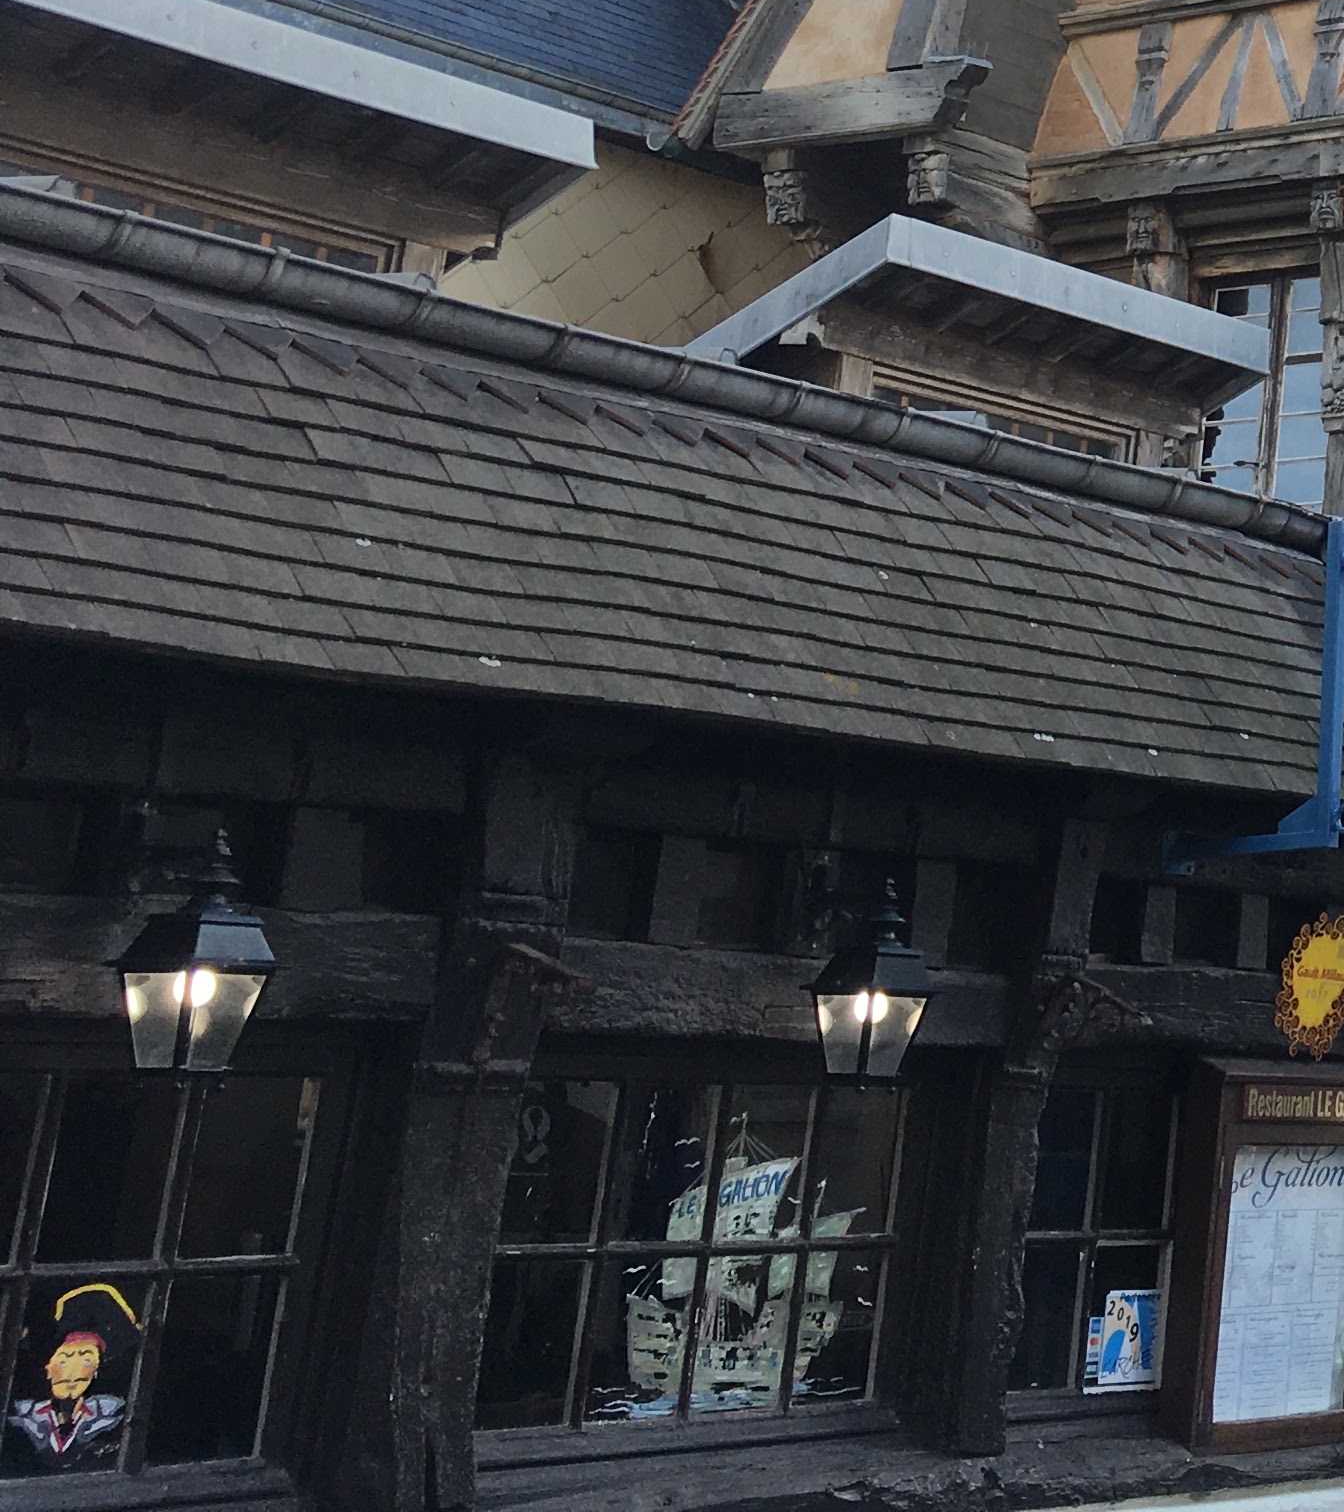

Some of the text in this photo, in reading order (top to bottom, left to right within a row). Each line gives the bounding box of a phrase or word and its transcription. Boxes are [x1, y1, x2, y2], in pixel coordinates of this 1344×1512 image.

[1248, 1088, 1314, 1118] Restaurant
[1317, 1090, 1334, 1118] LE
[719, 1169, 789, 1208] GALION
[1106, 1300, 1139, 1343] 2019
